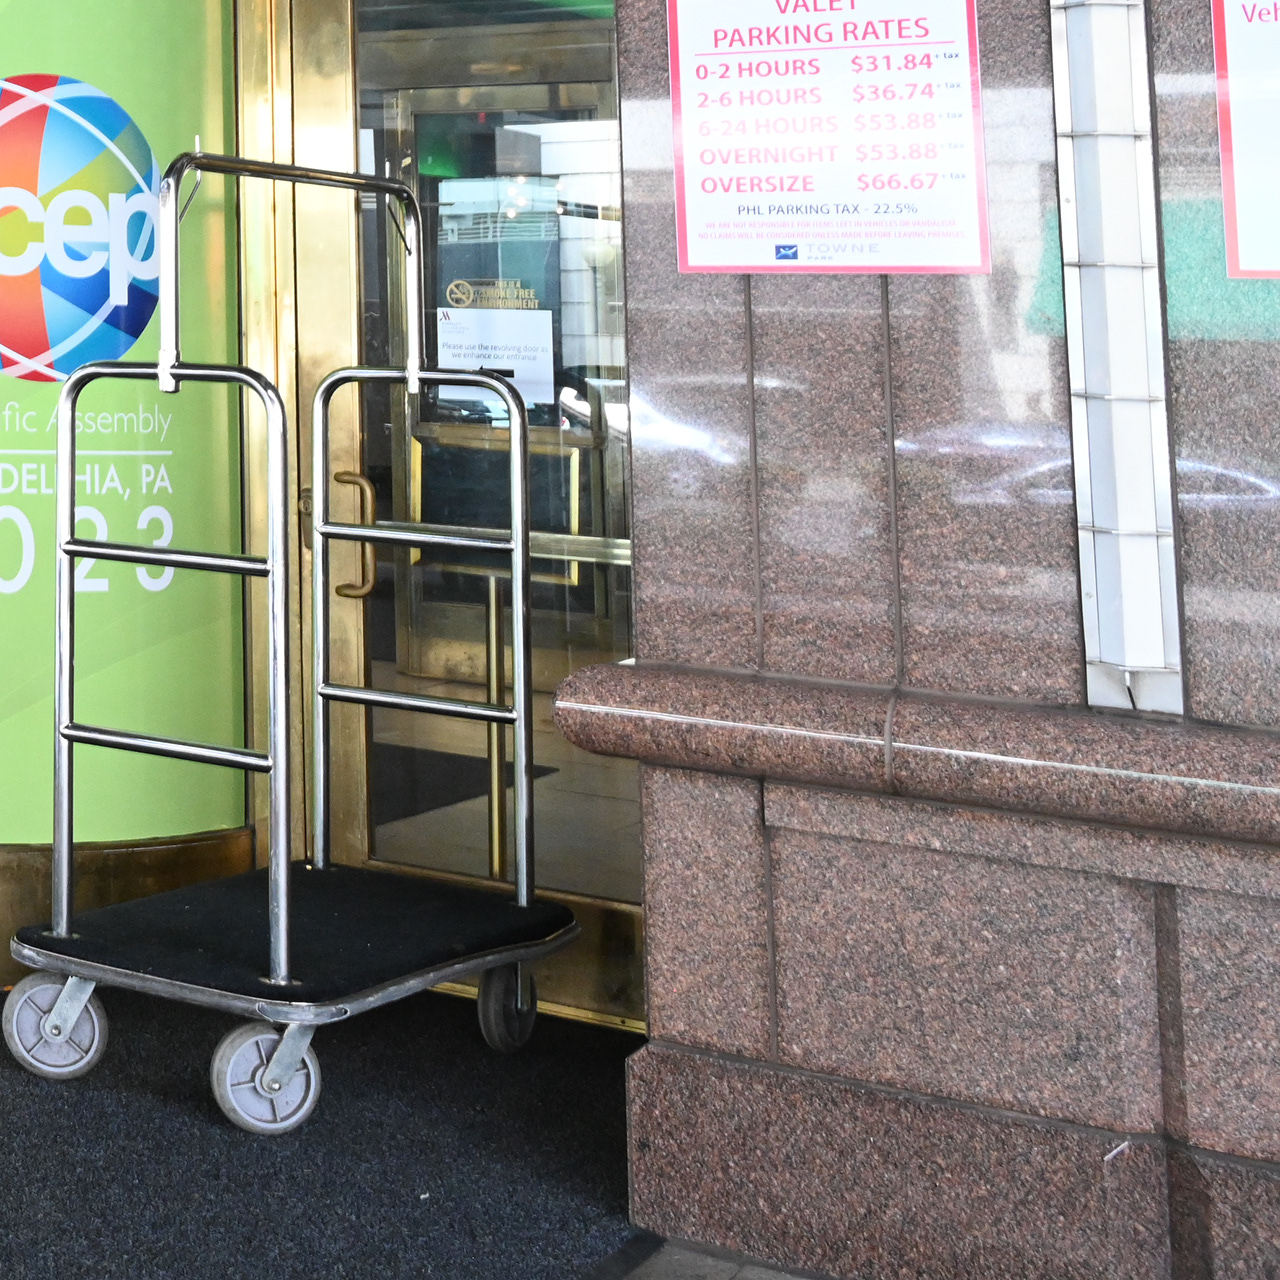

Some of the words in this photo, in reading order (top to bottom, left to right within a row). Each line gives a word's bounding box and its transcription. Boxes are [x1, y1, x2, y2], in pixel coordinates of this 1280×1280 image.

[713, 23, 833, 48] PARKING
[842, 17, 930, 41] RATES
[695, 63, 731, 80] 0-2
[738, 58, 821, 78] HOURS
[851, 53, 933, 73] $31.84
[697, 91, 732, 108] 2-6
[739, 87, 822, 106] HOURS
[852, 83, 935, 103] $36.74
[698, 119, 748, 137] 6-24
[755, 116, 838, 135] HOURS
[854, 112, 936, 133] $53.88
[699, 145, 839, 165] OVERNIGHT
[856, 142, 938, 162] $53.88
[701, 175, 815, 194] OVERSIZE
[857, 173, 938, 193] $66.67
[738, 204, 764, 216] PHL
[768, 204, 830, 215] PARKING
[833, 203, 860, 215] TAX
[873, 203, 918, 214] 22.5%
[806, 243, 880, 253] TOWNE
[514, 289, 535, 298] FREE
[442, 342, 463, 350] Please
[491, 344, 521, 353] revolving
[523, 344, 539, 352] door
[142, 463, 173, 494] PA
